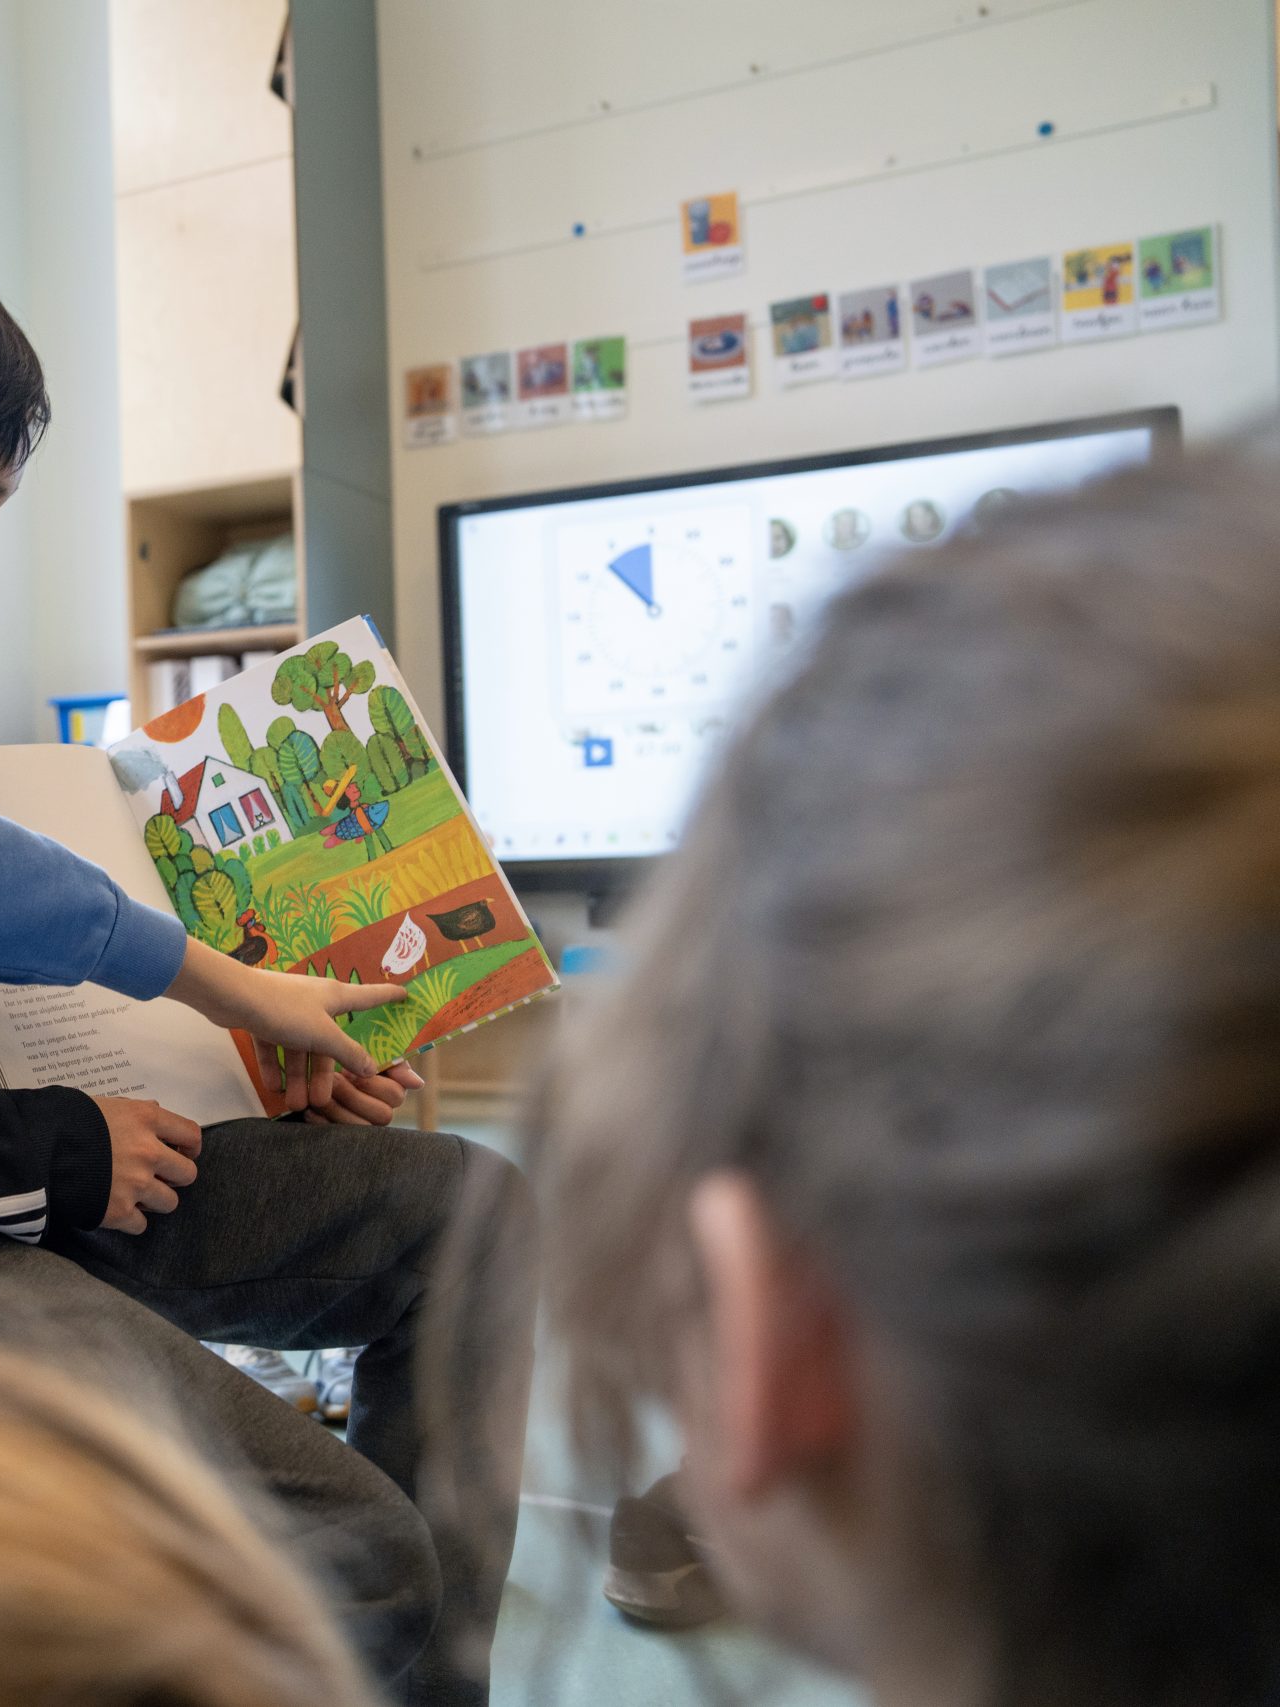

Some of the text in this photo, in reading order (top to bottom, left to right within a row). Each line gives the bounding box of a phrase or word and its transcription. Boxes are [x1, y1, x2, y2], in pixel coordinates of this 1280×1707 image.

[91, 1008, 115, 1018] gelukkig
[46, 1036, 66, 1045] jongen
[39, 1050, 48, 1059] hij
[57, 1059, 80, 1068] begreep
[81, 1055, 93, 1064] zijn
[94, 1051, 113, 1060] vriend
[47, 1074, 65, 1082] omdat
[76, 1069, 89, 1077] veel
[80, 1081, 97, 1089] onder
